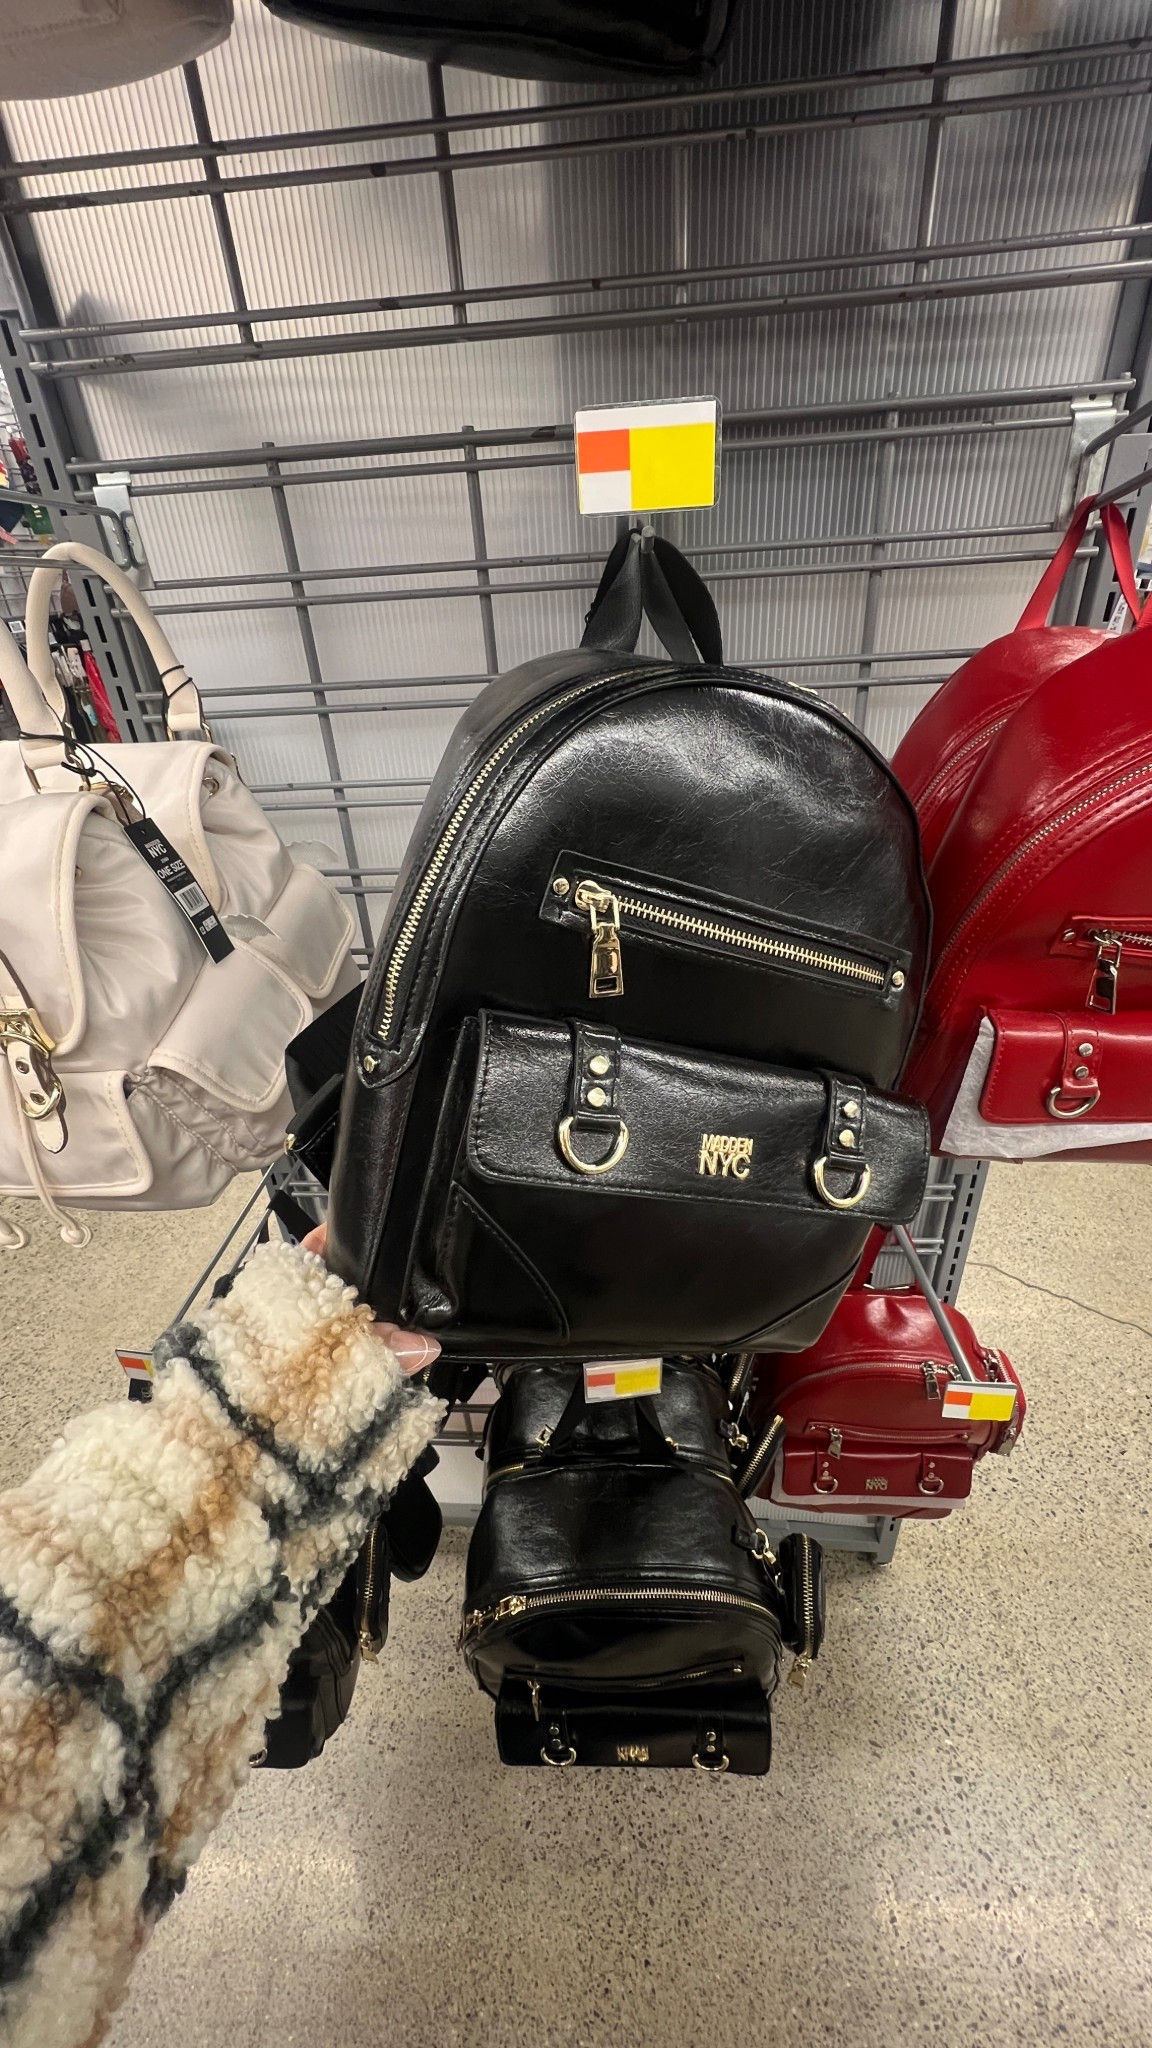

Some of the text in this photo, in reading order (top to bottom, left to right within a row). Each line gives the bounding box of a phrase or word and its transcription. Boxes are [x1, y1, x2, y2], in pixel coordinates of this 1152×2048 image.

[147, 843, 168, 858] NYC
[156, 865, 174, 879] ONE
[170, 859, 186, 872] SIZE
[701, 1133, 754, 1156] MADDEN
[698, 1149, 751, 1180] NYC
